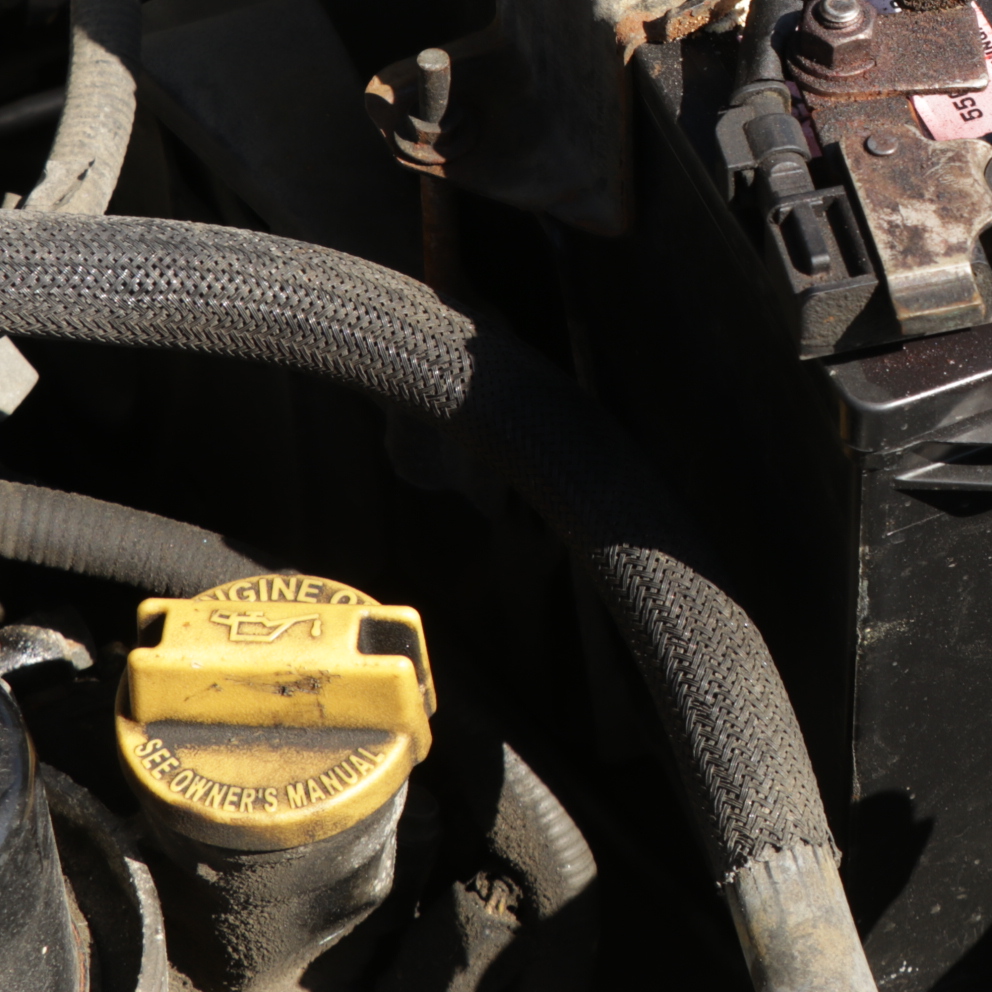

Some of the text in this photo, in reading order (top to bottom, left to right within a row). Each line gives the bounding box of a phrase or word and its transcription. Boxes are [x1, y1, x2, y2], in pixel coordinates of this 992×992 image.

[134, 738, 385, 814] SEE OWNER'S MANUAL
